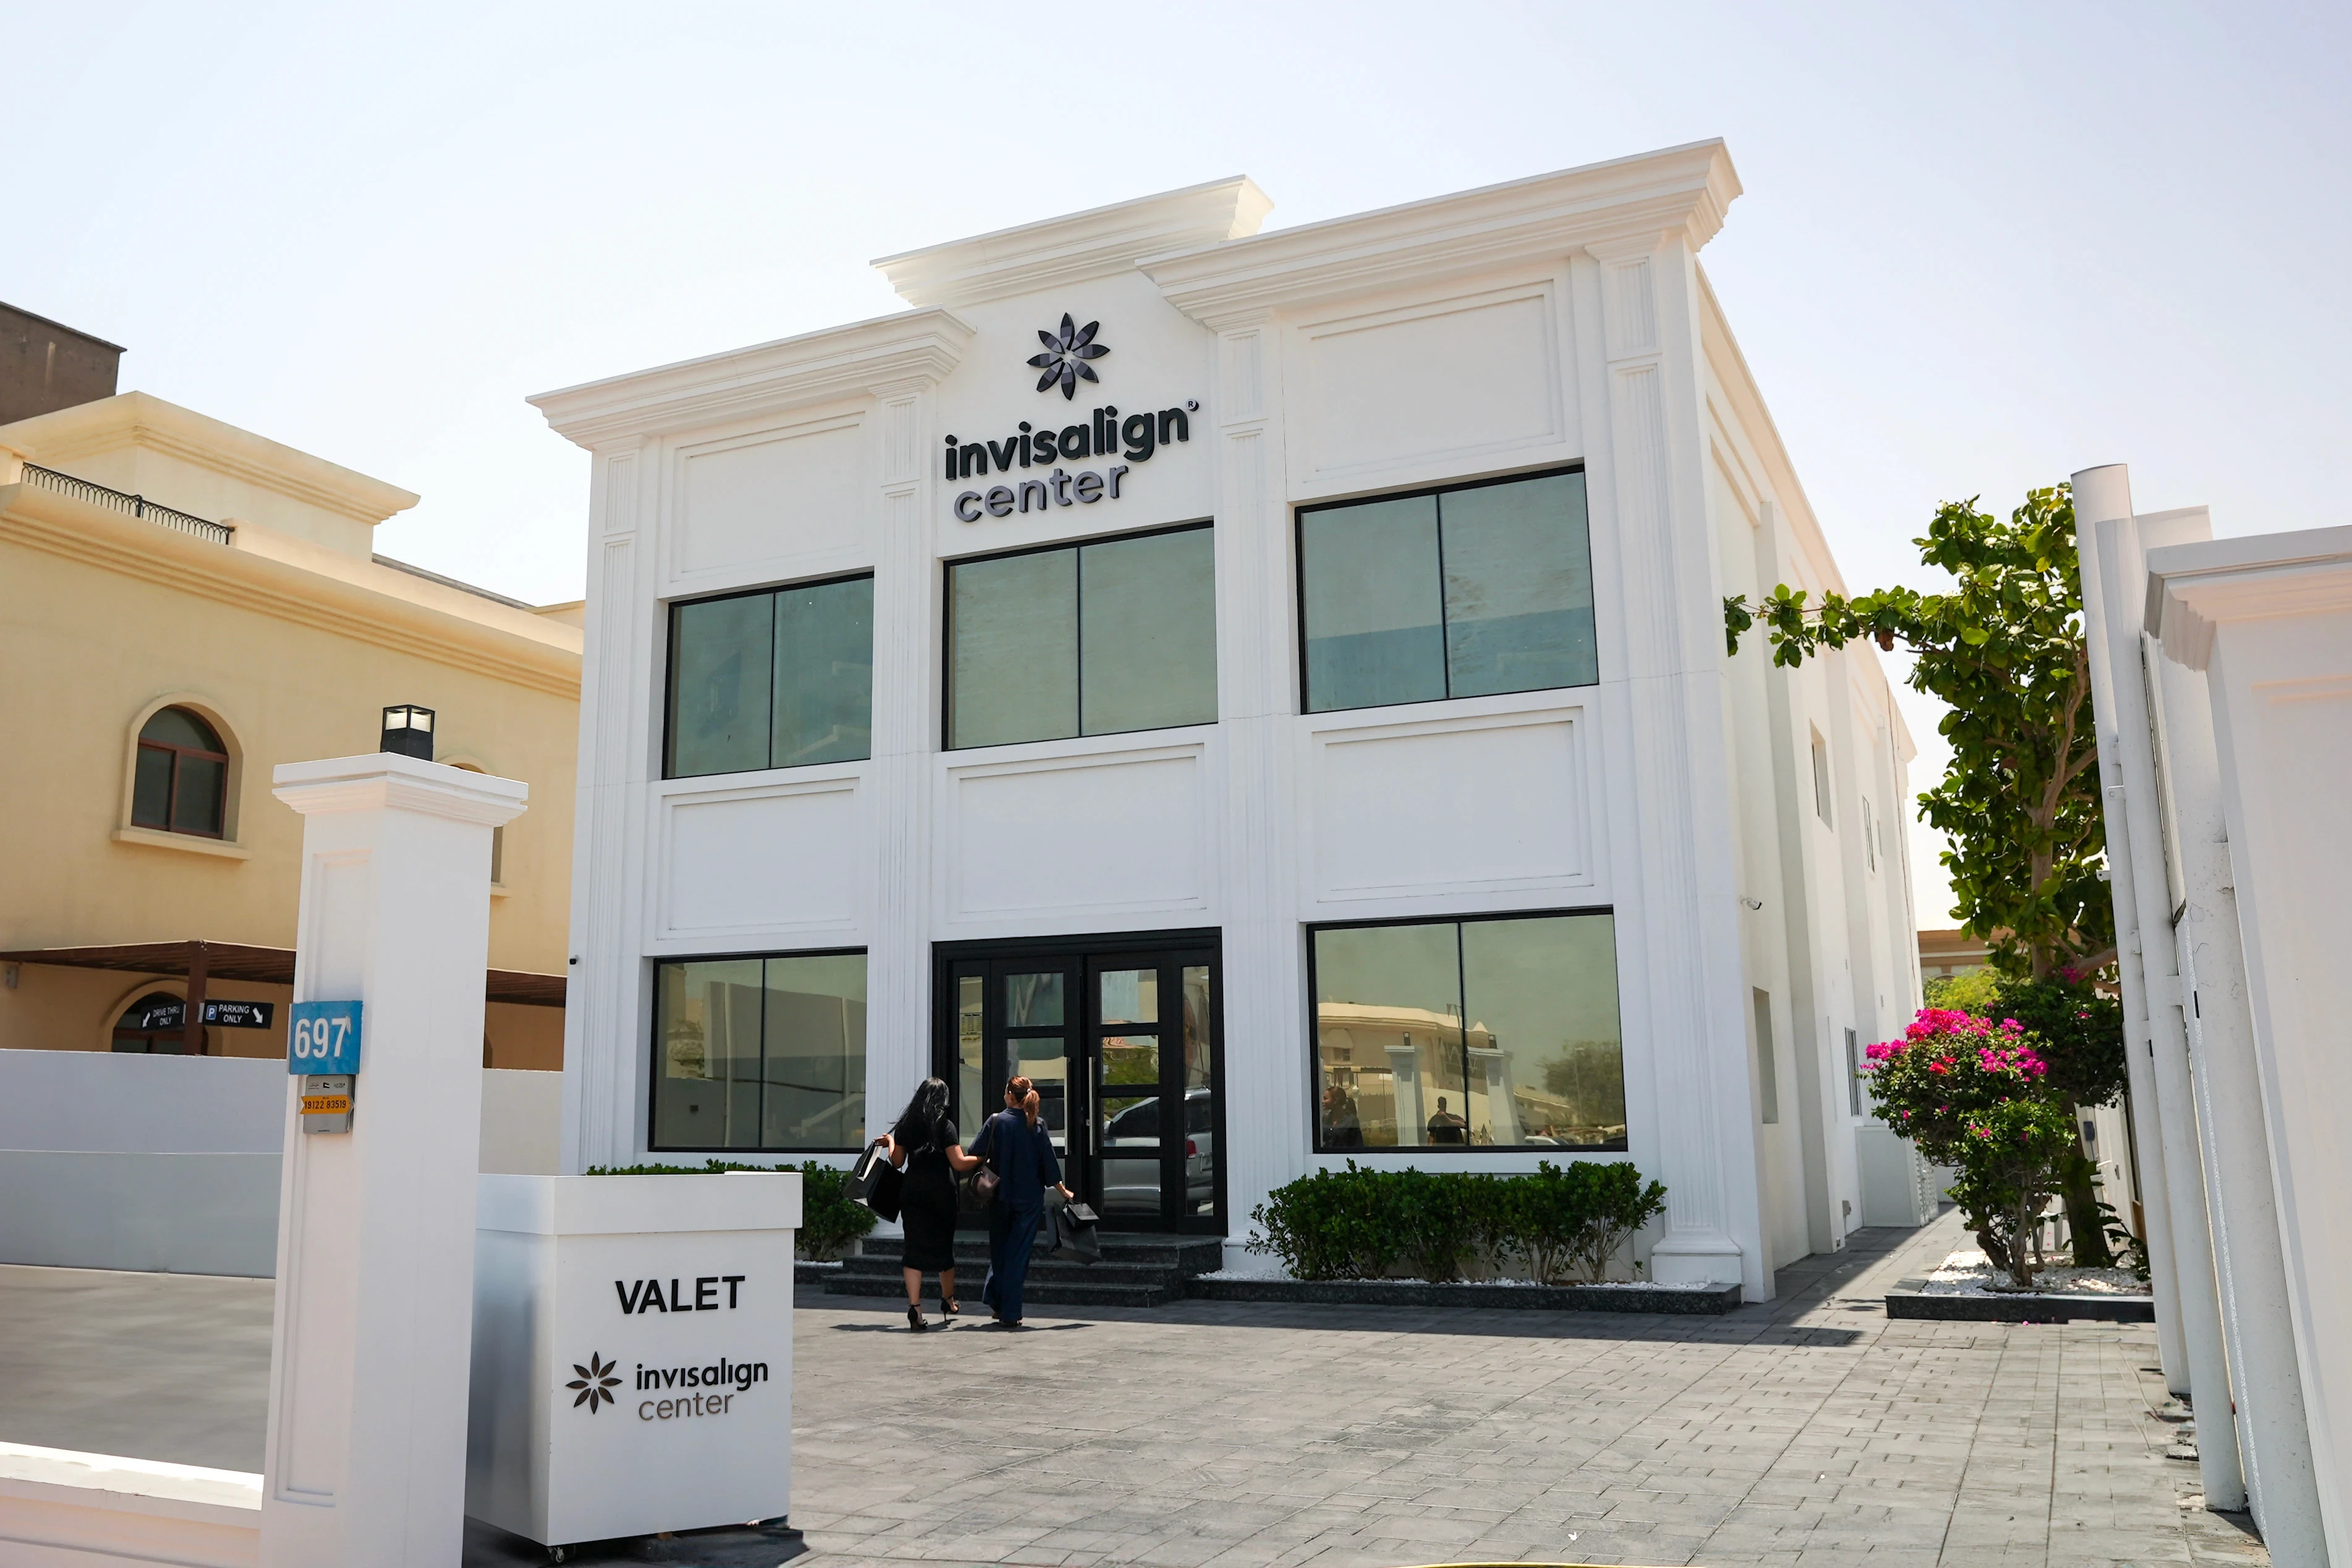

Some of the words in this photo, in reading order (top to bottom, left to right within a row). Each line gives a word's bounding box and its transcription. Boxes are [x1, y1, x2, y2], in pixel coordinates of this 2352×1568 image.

[954, 465, 1128, 522] center
[153, 1008, 166, 1018] DRIVE
[218, 1004, 250, 1014] PARKING
[160, 1016, 172, 1026] ONLY
[223, 1015, 242, 1023] ONLY
[294, 1016, 351, 1059] 697
[305, 1101, 324, 1109] 19122
[326, 1100, 346, 1109] 83519
[615, 1276, 745, 1314] VALET
[636, 1358, 768, 1391] invisalign
[639, 1392, 734, 1420] center
